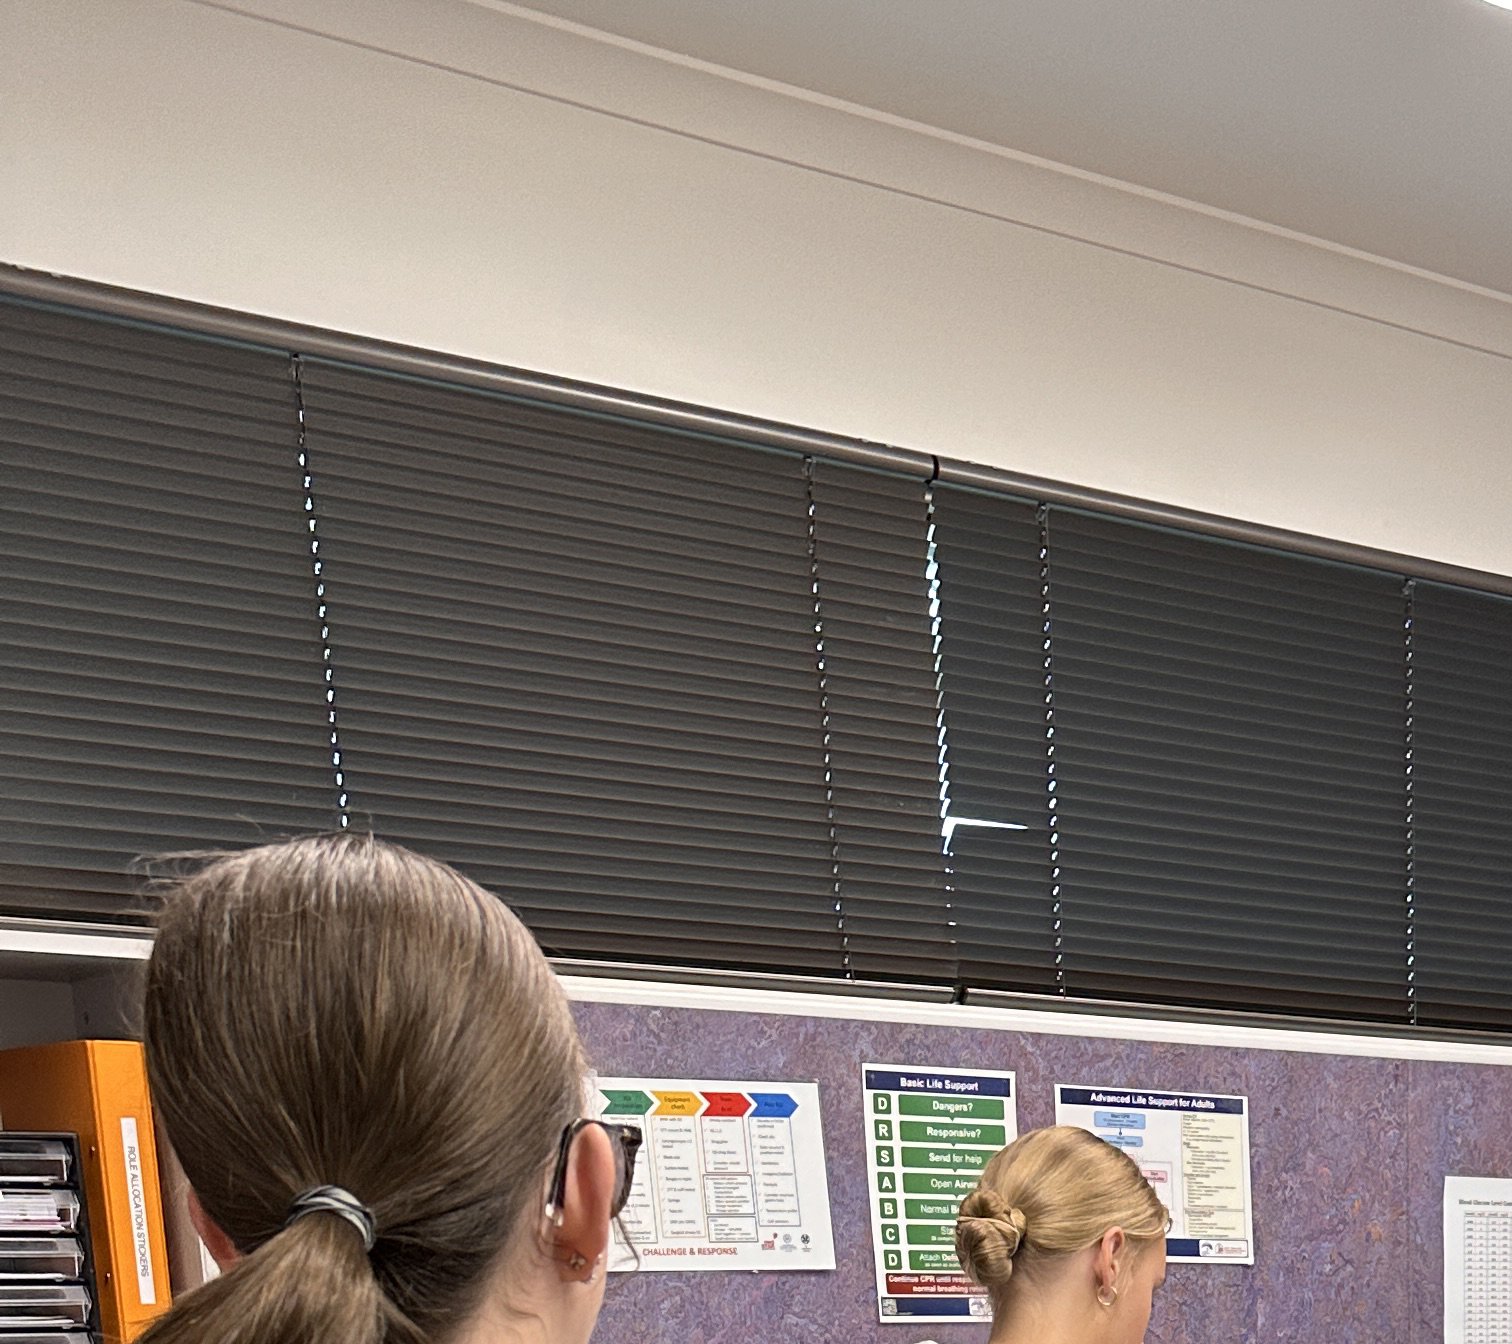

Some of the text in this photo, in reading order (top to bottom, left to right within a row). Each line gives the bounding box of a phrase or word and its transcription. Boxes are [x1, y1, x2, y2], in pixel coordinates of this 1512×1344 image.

[900, 1077, 979, 1091] Basic Life Support
[878, 1097, 974, 1113] D Dangers?
[1090, 1093, 1215, 1109] Advanced Life Support for Adults
[879, 1124, 982, 1139] R Responsive?
[880, 1150, 982, 1165] S Send for help
[881, 1176, 893, 1189] A
[930, 1178, 952, 1189] Open
[127, 1146, 150, 1277] ROLE ALLOCATION STICKERS
[884, 1202, 894, 1215] B
[920, 1205, 950, 1214] Normal
[885, 1228, 896, 1241] C
[642, 1247, 738, 1256] CHALLENGE & RESPONSE
[888, 1253, 898, 1266] D
[888, 1275, 919, 1283] Continue
[937, 1285, 968, 1294] breathing
